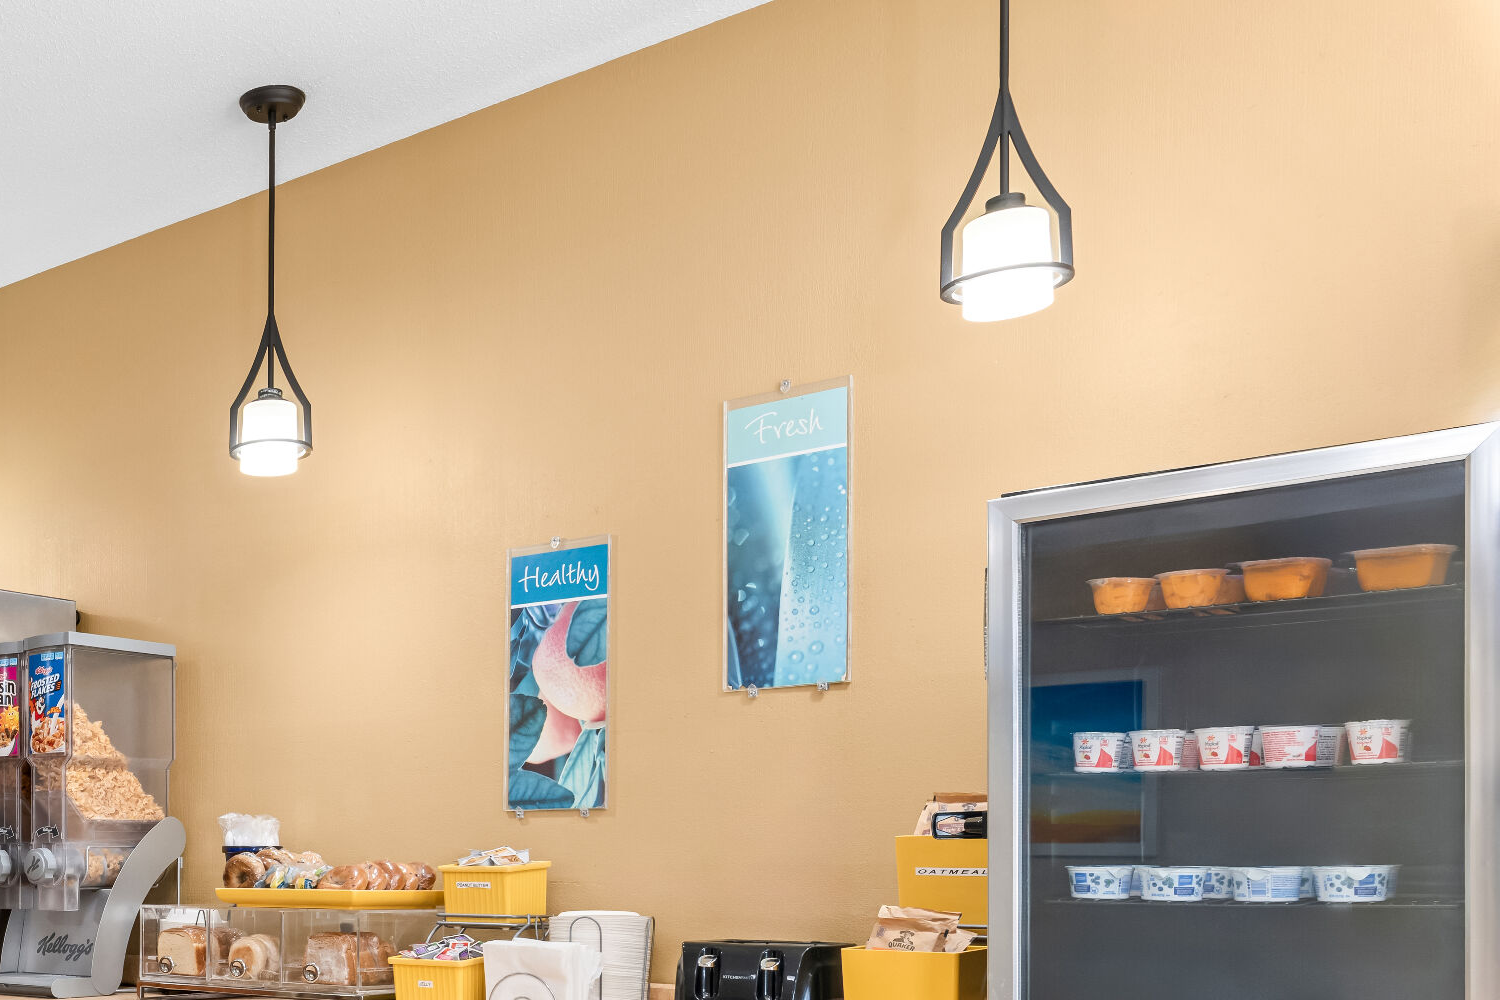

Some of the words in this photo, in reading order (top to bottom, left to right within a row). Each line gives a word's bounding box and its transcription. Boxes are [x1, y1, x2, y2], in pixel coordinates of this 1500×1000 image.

[744, 407, 824, 444] Fresh
[517, 560, 600, 593] Healthy
[30, 672, 60, 690] FROSTED
[30, 681, 56, 699] FLAKES
[36, 931, 94, 962] Kellogg's
[887, 941, 916, 952] QUAKER
